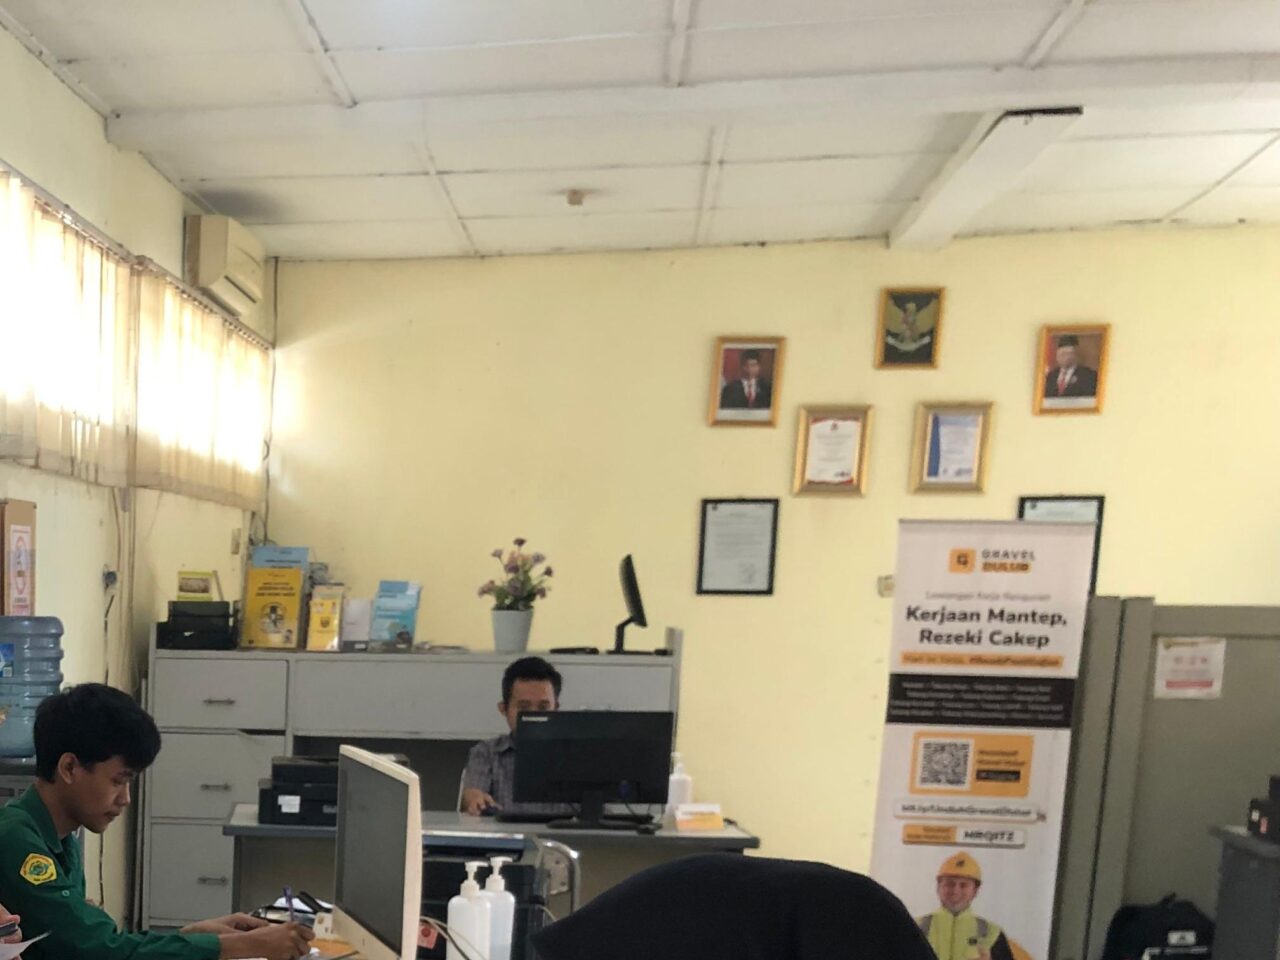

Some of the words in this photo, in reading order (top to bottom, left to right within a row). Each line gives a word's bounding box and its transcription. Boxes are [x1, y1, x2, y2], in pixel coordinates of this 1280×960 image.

[981, 549, 1035, 561] GRAVEL
[906, 605, 981, 626] Kerjaan
[987, 608, 1068, 627] Mantep,
[919, 629, 983, 646] Rezeki
[989, 630, 1051, 650] Cakep
